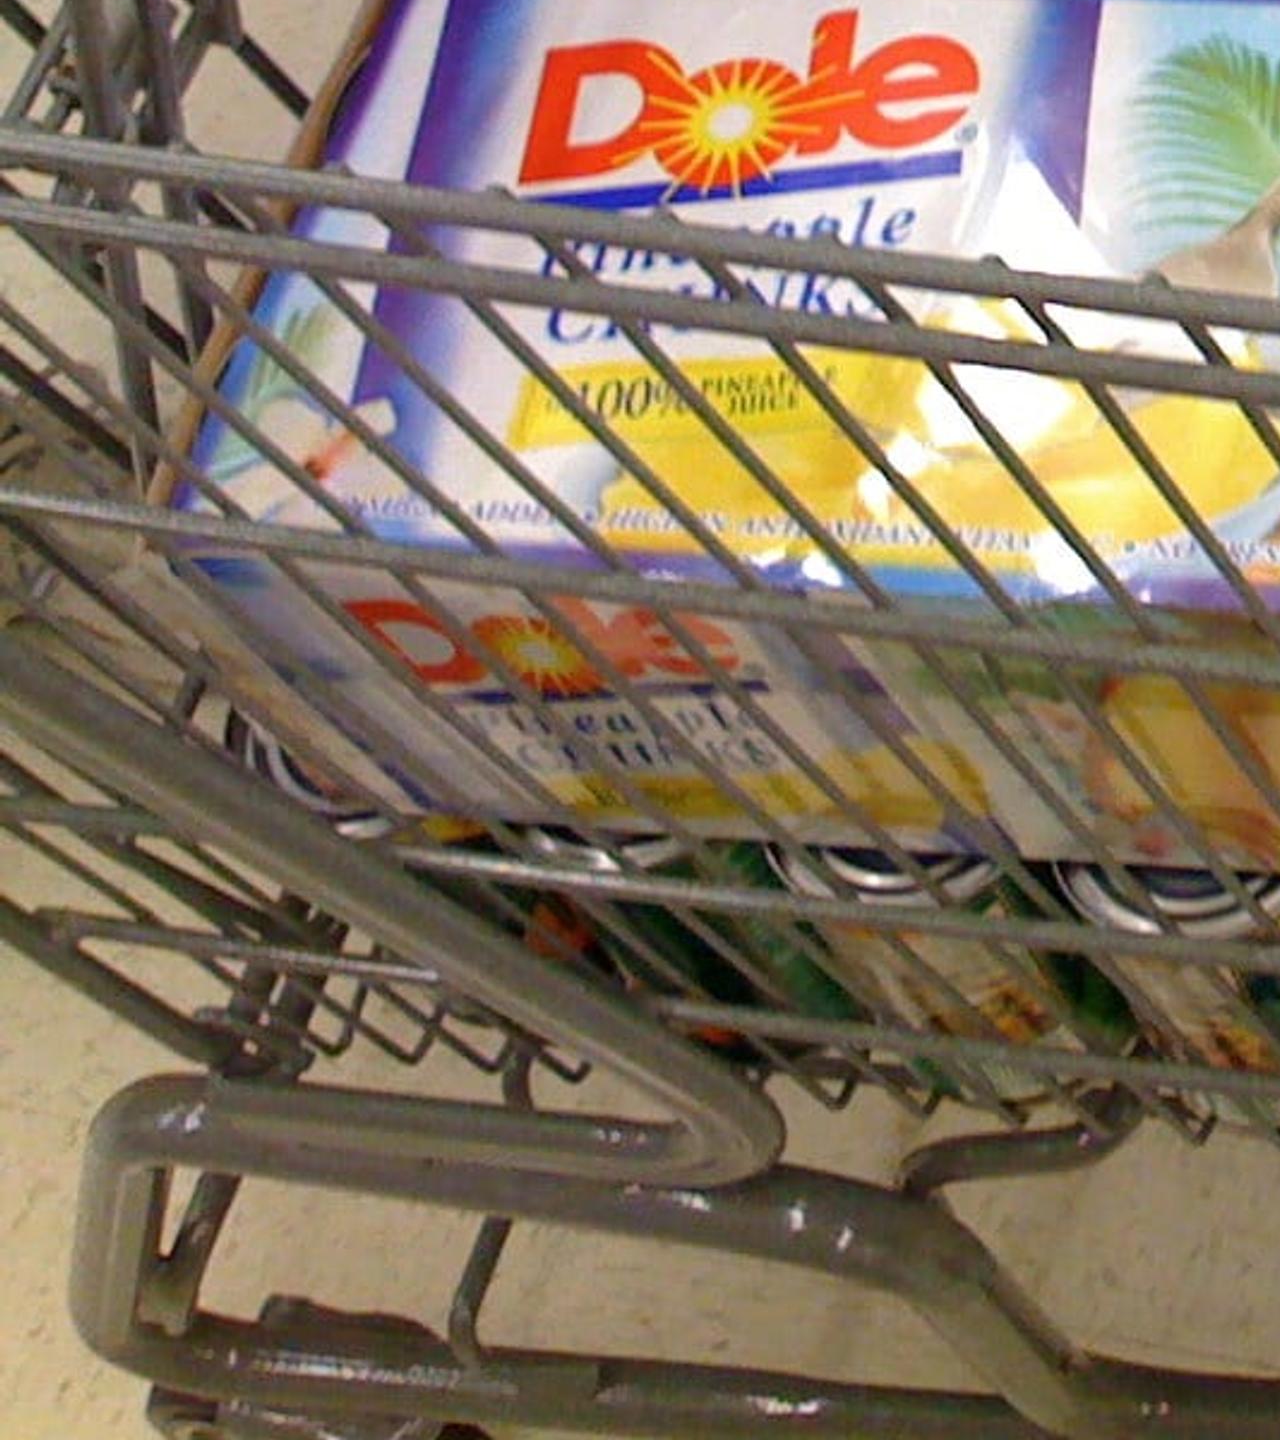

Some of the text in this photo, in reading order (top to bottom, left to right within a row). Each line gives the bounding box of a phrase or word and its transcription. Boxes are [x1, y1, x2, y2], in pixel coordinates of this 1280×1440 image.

[517, 6, 982, 188] Dole
[542, 194, 917, 286] inpple
[701, 366, 839, 394] PINEAPE
[342, 594, 742, 696] Dole
